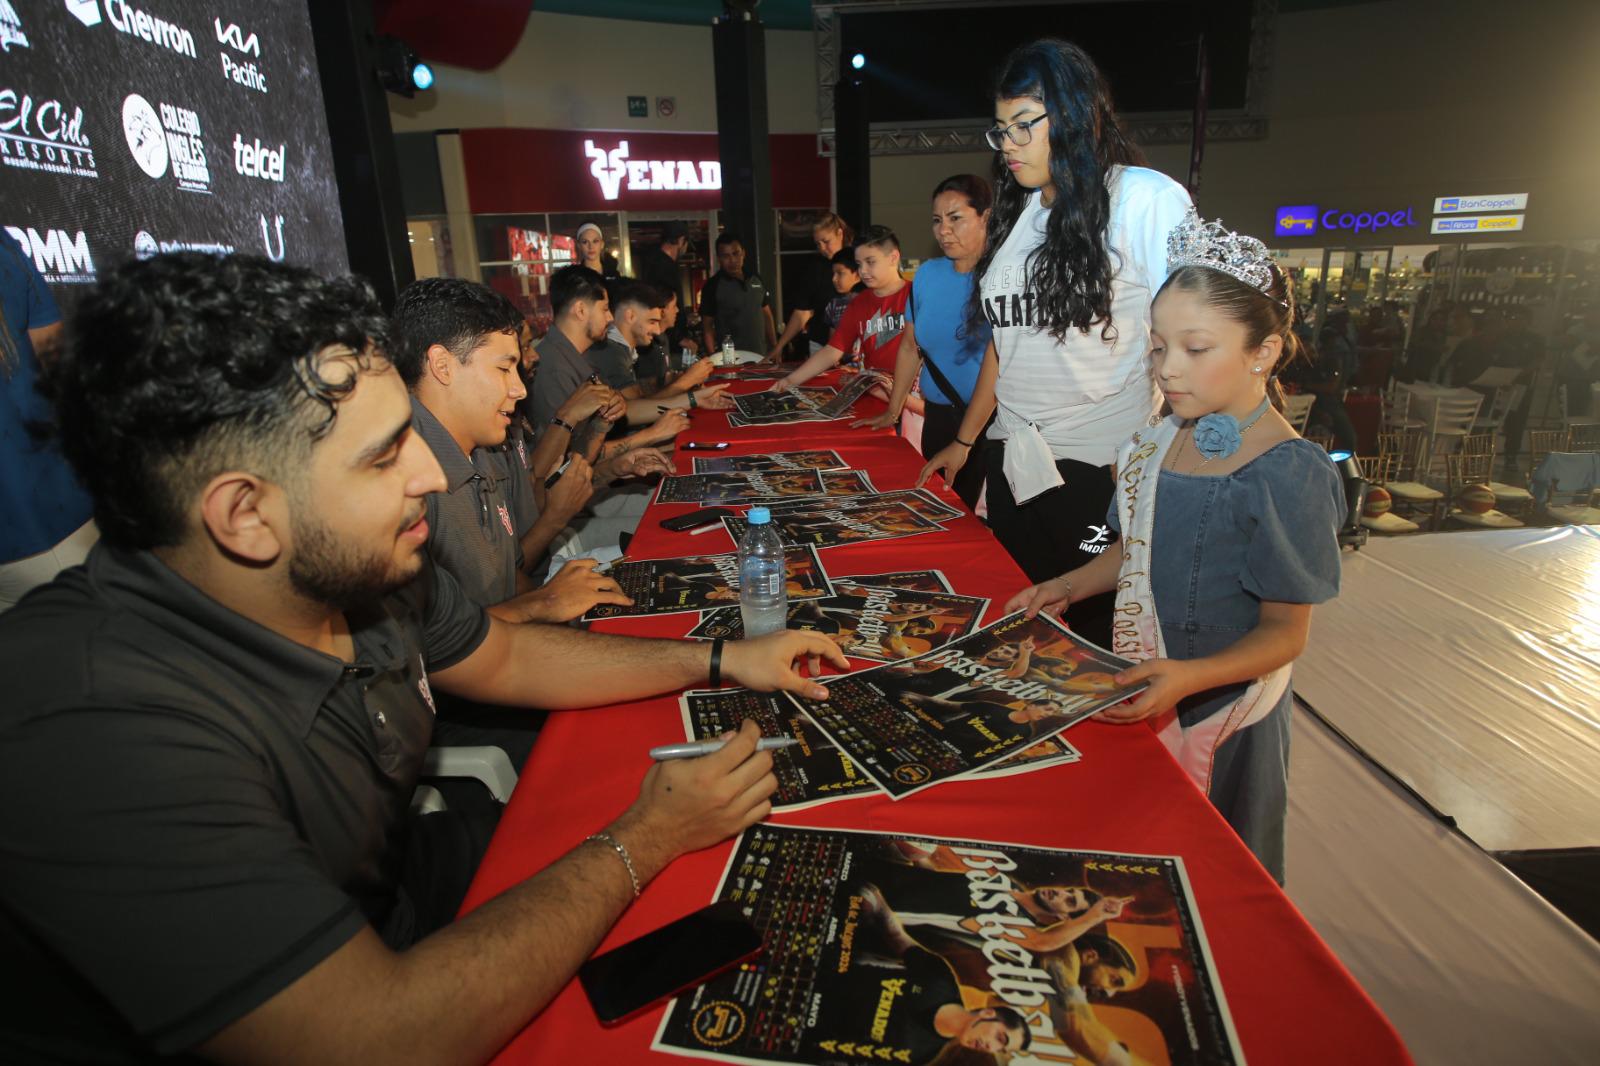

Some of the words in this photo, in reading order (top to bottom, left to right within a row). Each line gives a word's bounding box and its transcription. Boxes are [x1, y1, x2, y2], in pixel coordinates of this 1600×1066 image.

[105, 0, 197, 58] Chevron
[221, 52, 267, 93] Pacific
[0, 138, 96, 168] RESORTS
[233, 133, 284, 182] telcel
[1321, 207, 1417, 233] Coppel
[1460, 198, 1516, 209] BanCoppel
[921, 649, 1096, 715] Basketball
[841, 851, 853, 881] MARZO
[826, 916, 838, 945] ABRIL
[949, 847, 1079, 1066] Basketball
[807, 993, 822, 1028] MAYO
